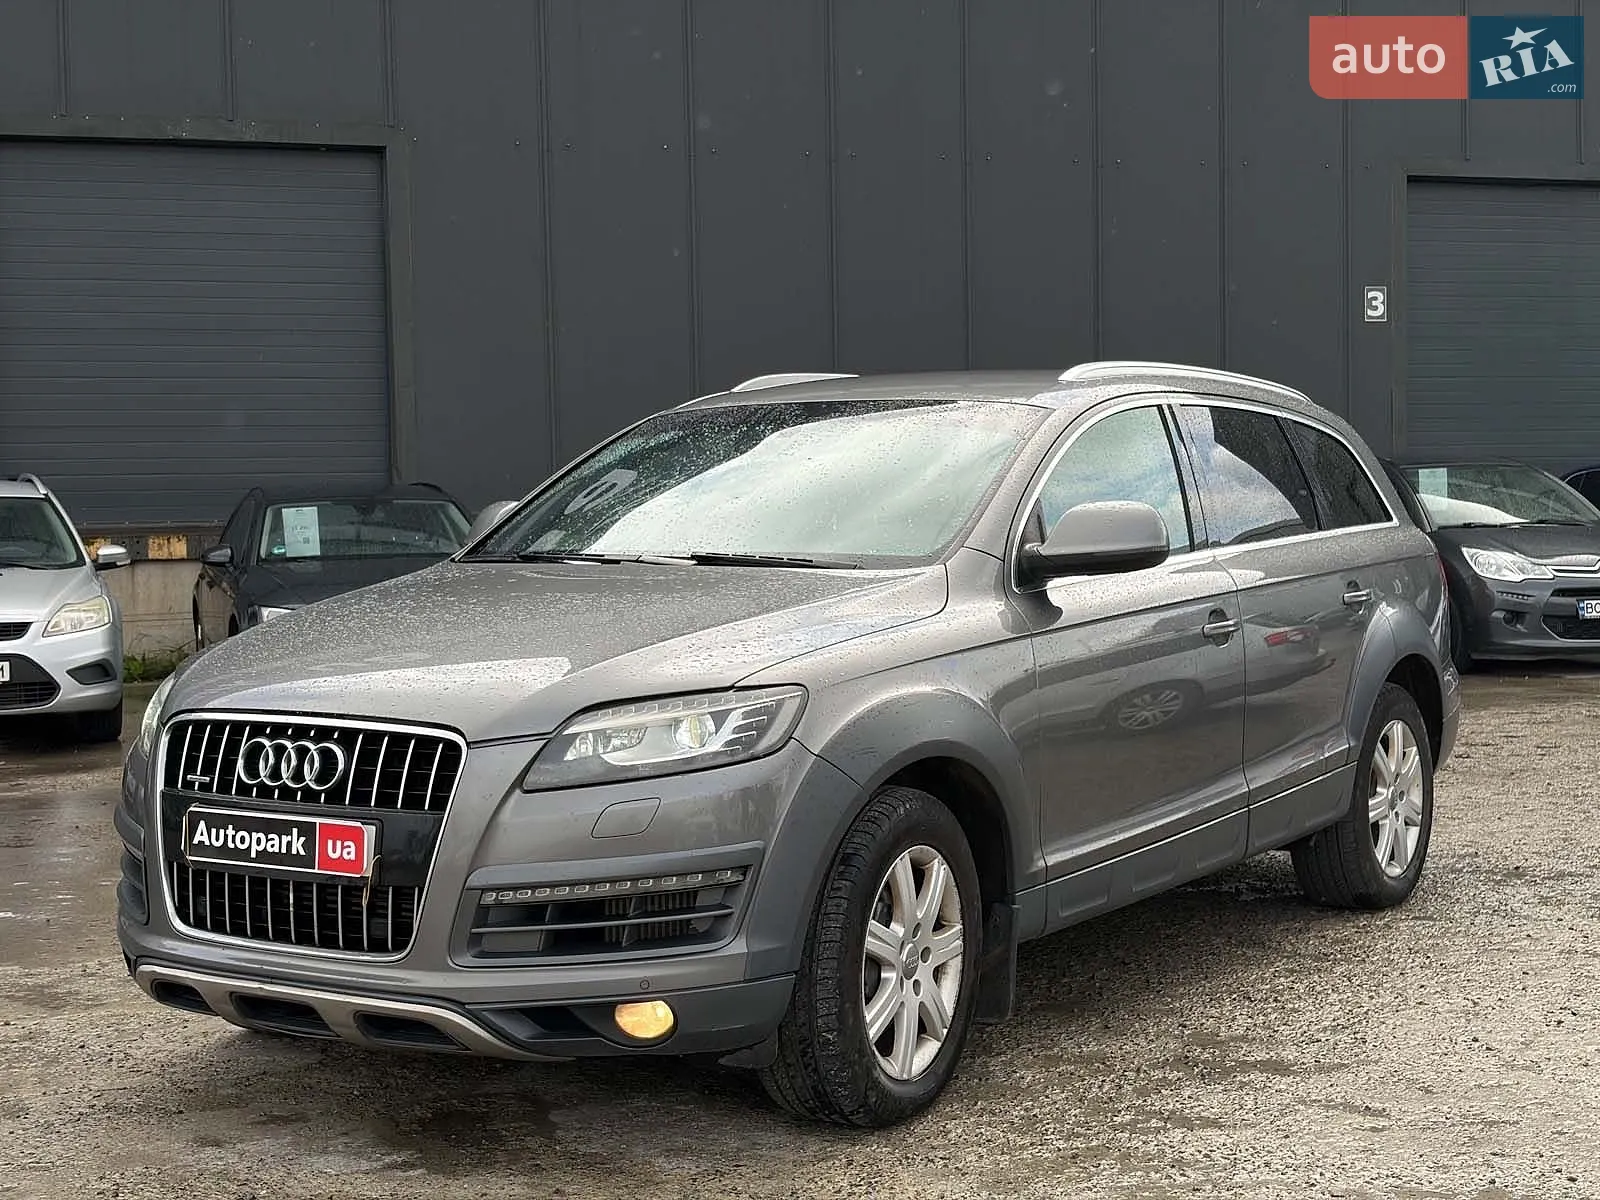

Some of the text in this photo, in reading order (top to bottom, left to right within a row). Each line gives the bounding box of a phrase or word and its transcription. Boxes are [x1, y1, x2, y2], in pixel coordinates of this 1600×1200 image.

[1367, 291, 1385, 317] 3
[192, 820, 356, 861] Autopark ua
